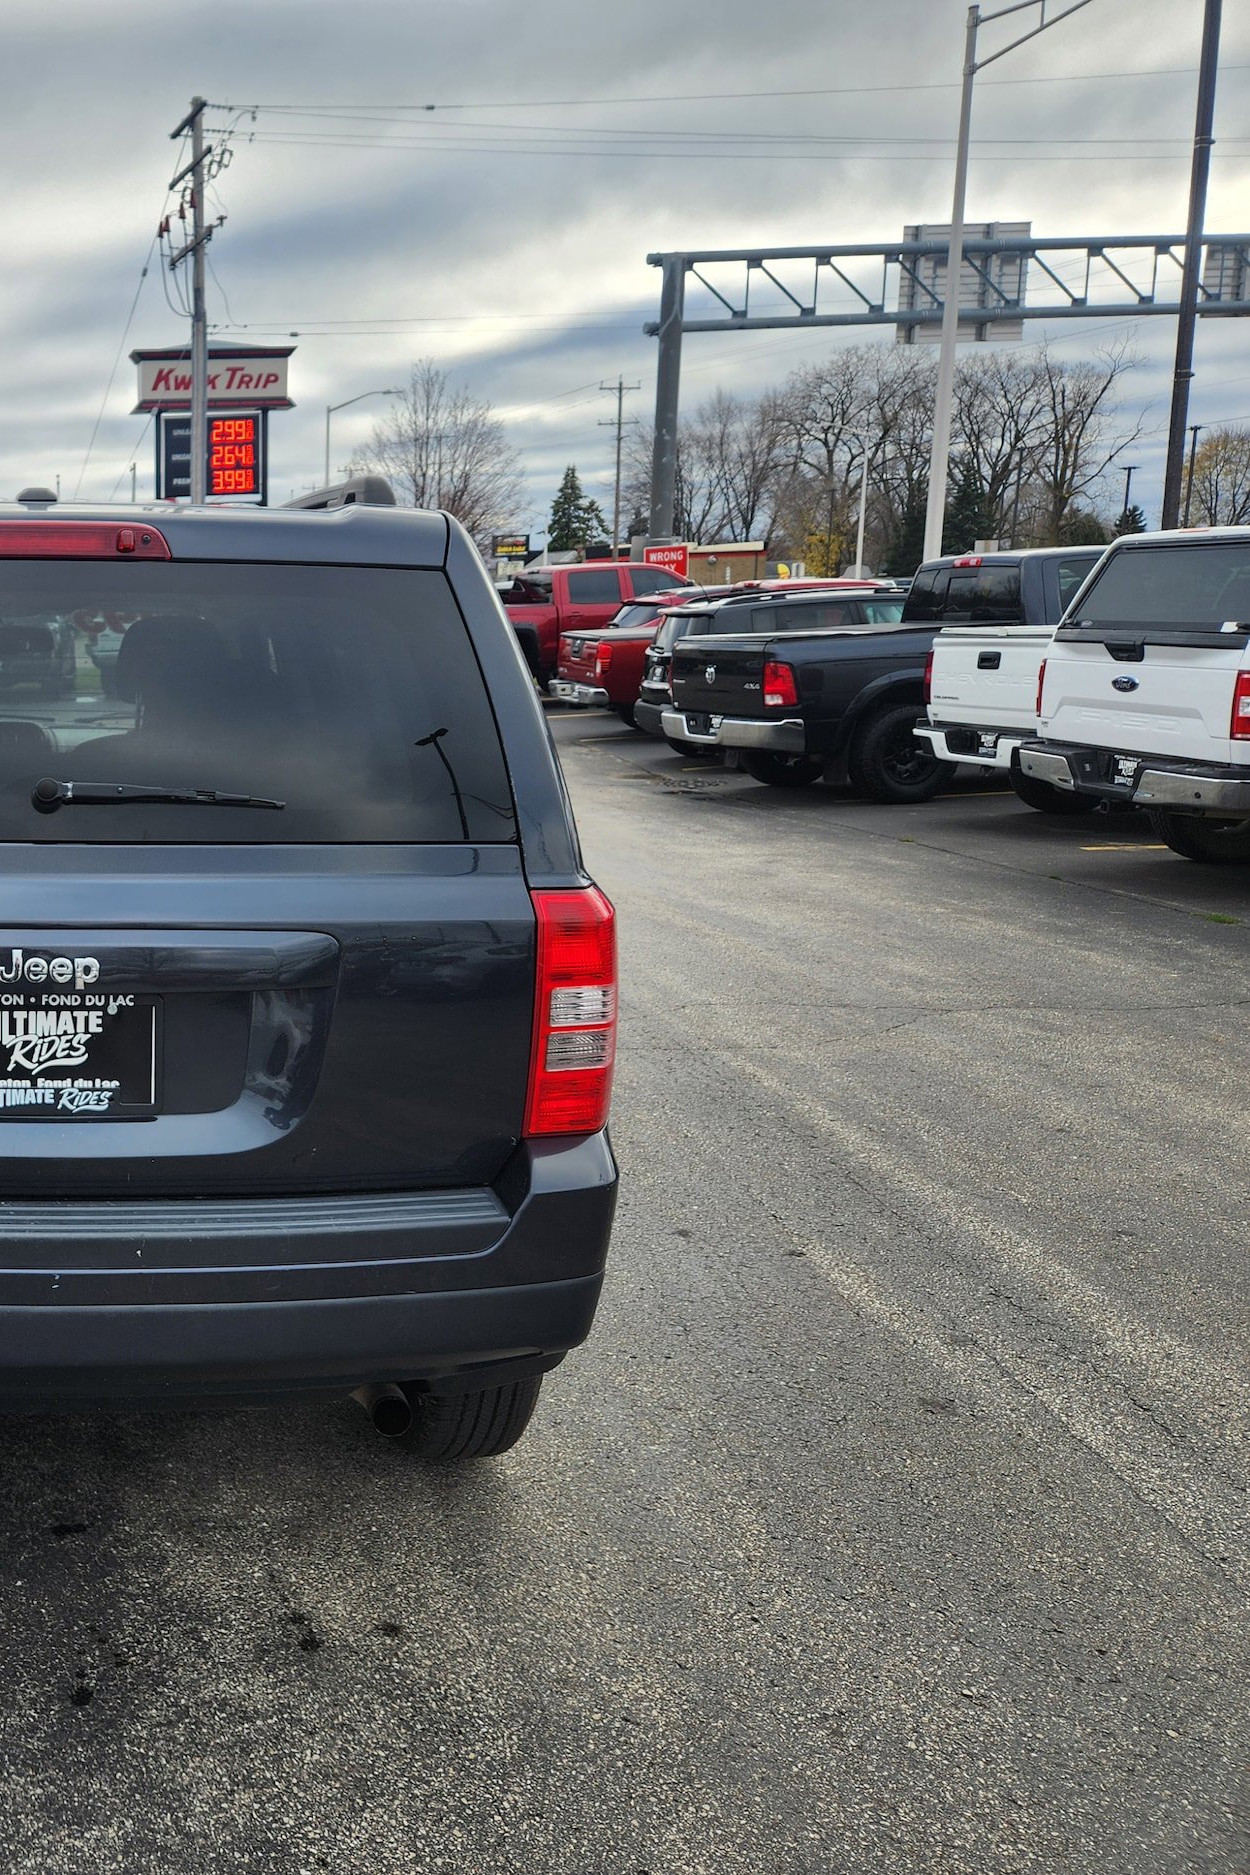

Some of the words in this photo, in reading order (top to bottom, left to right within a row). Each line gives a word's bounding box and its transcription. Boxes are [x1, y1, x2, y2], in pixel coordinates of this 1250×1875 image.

[151, 368, 221, 391] KWK
[225, 366, 279, 390] TRIP
[649, 551, 684, 562] WRONG
[935, 672, 1038, 688] CHEVROLE
[41, 994, 83, 1006] FOND
[85, 994, 105, 1006] DU
[109, 994, 135, 1006] LAC
